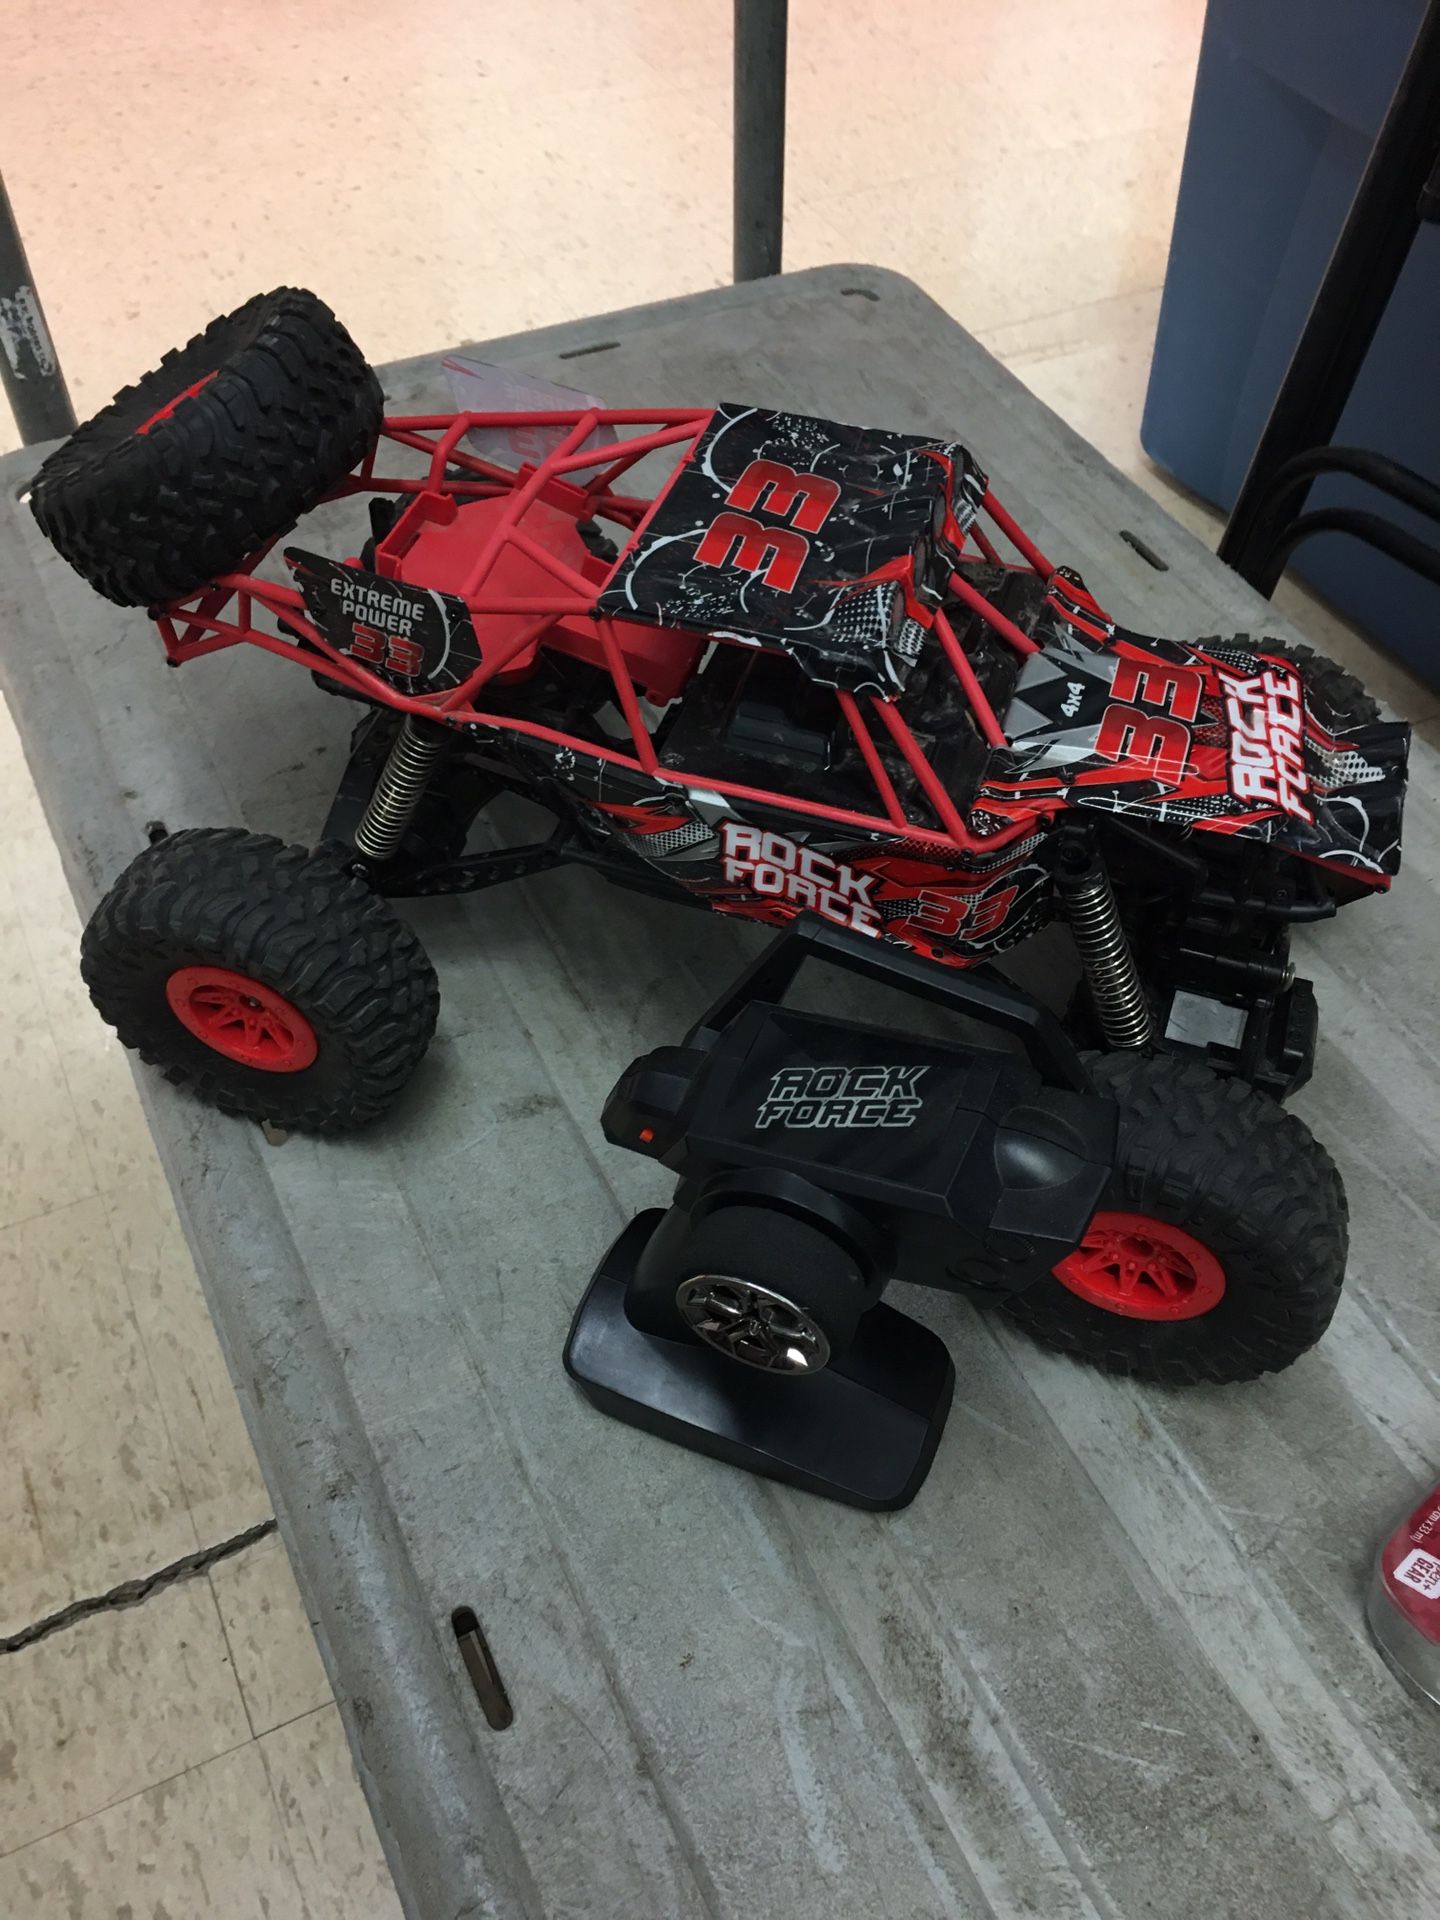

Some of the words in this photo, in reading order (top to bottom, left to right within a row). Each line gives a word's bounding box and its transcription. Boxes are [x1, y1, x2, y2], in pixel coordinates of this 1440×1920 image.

[693, 459, 842, 594] 33
[330, 578, 425, 622] EXTREME
[342, 600, 415, 637] POWER
[350, 622, 425, 668] 33
[1094, 657, 1203, 786] 33
[1218, 671, 1279, 801] ROCK
[1262, 669, 1313, 822] FORCE
[721, 822, 876, 905] ROCK
[723, 857, 881, 939] FORCE
[905, 884, 1020, 942] 33
[767, 1065, 932, 1101] ROCK
[754, 1097, 923, 1129] FORCE
[1418, 1522, 1433, 1535] 33
[1403, 1557, 1434, 1584] GEAR
